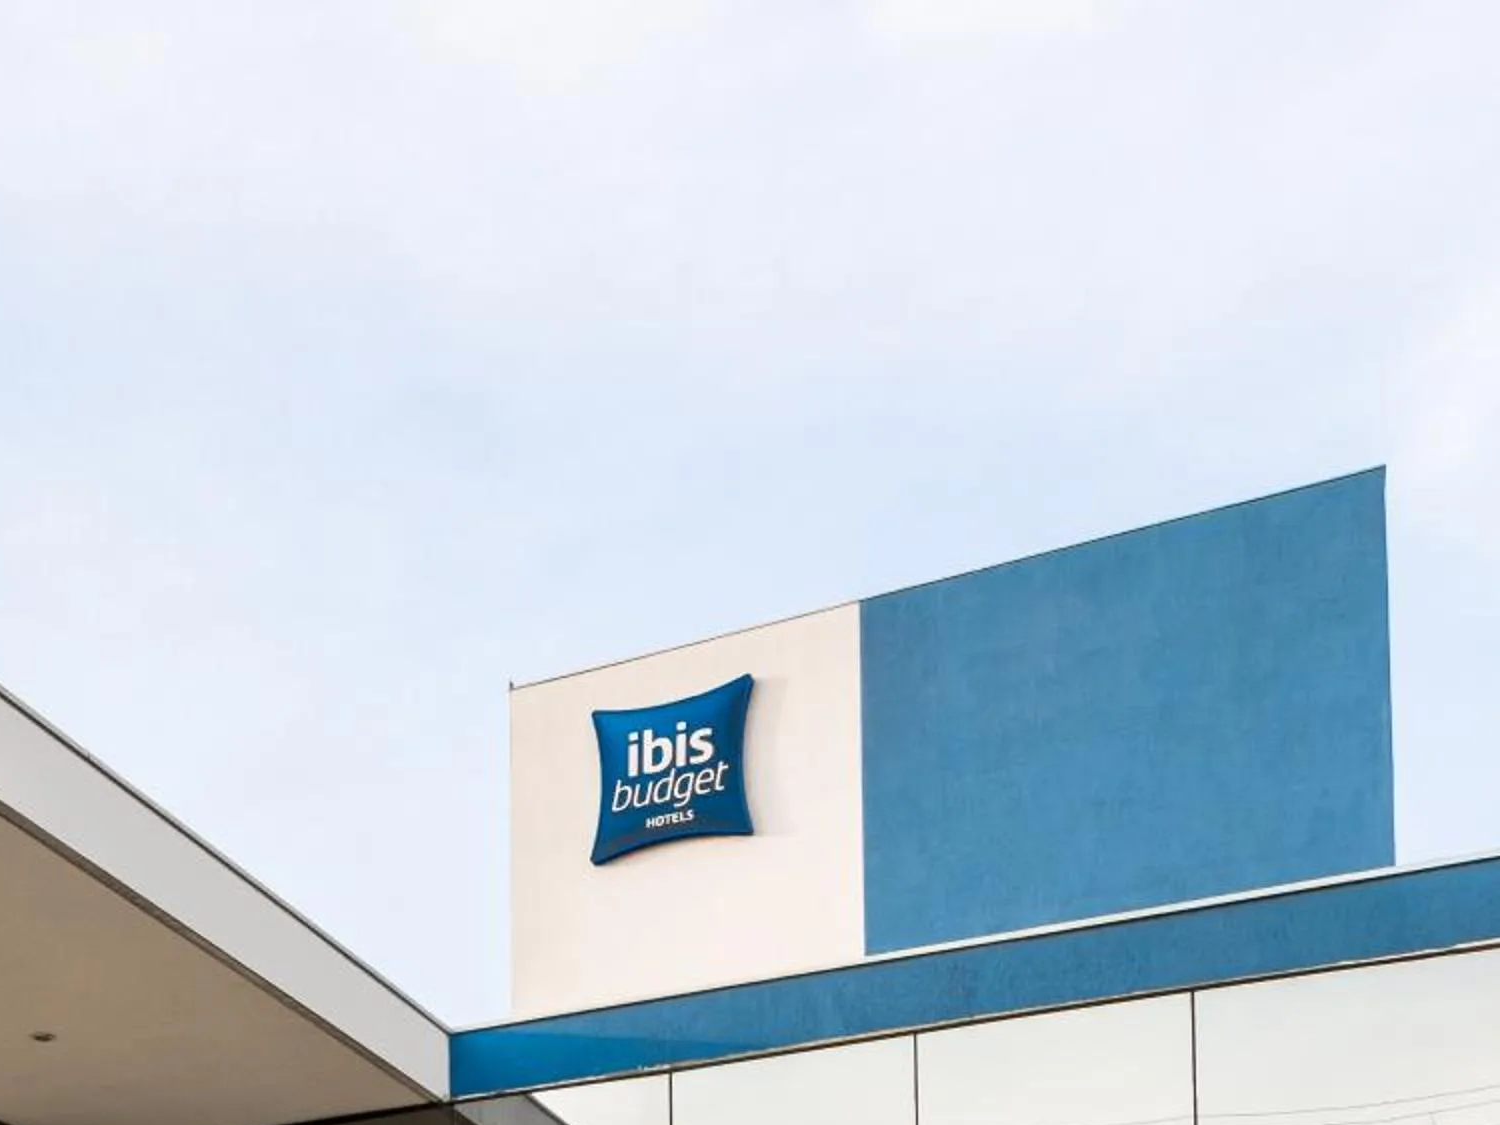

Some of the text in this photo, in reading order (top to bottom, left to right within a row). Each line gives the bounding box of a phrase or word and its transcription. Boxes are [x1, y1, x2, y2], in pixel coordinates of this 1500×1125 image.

[627, 721, 715, 777] ibis
[611, 760, 729, 812] budget
[645, 809, 695, 829] HOTELS
